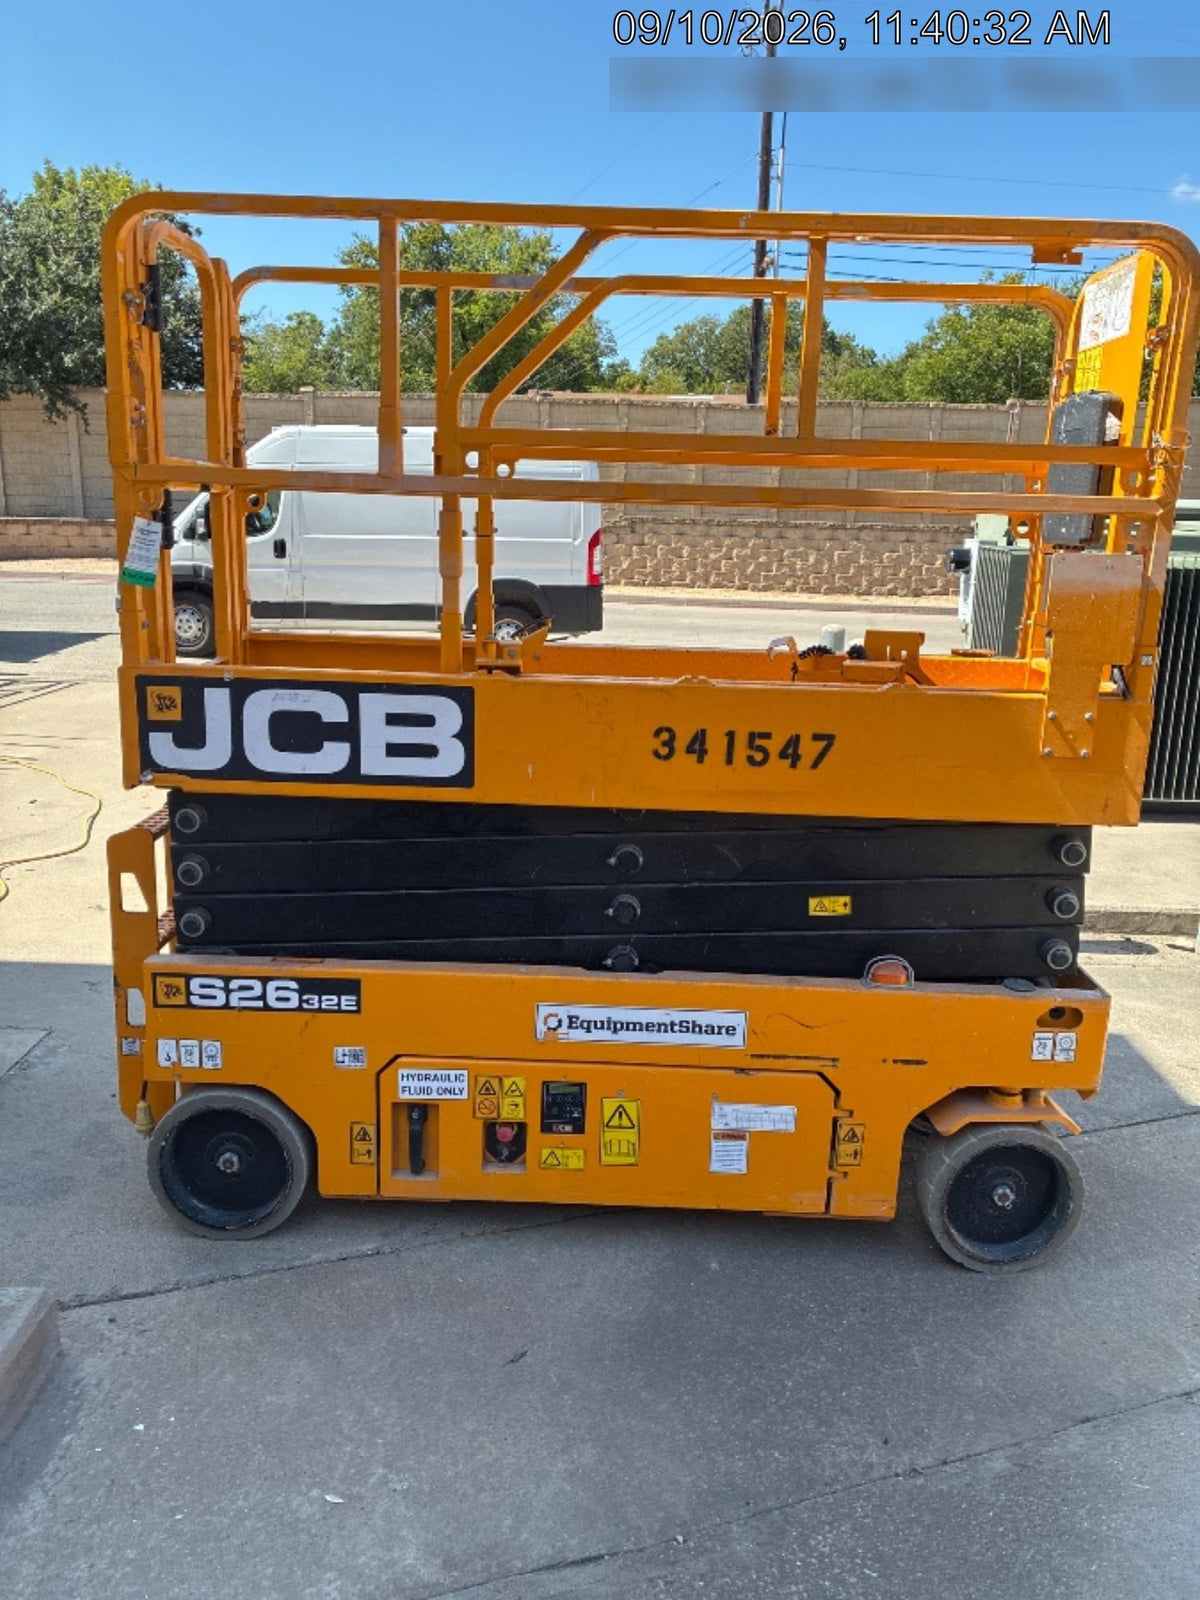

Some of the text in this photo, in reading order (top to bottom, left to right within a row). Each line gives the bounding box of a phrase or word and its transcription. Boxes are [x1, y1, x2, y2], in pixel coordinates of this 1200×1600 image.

[148, 687, 466, 778] JCB
[652, 726, 837, 770] 341547
[189, 977, 300, 1009] S26
[566, 1014, 738, 1037] EquipmentShare
[401, 1072, 465, 1084] HYDRAULIC
[401, 1085, 465, 1096] FLUID ONLY
